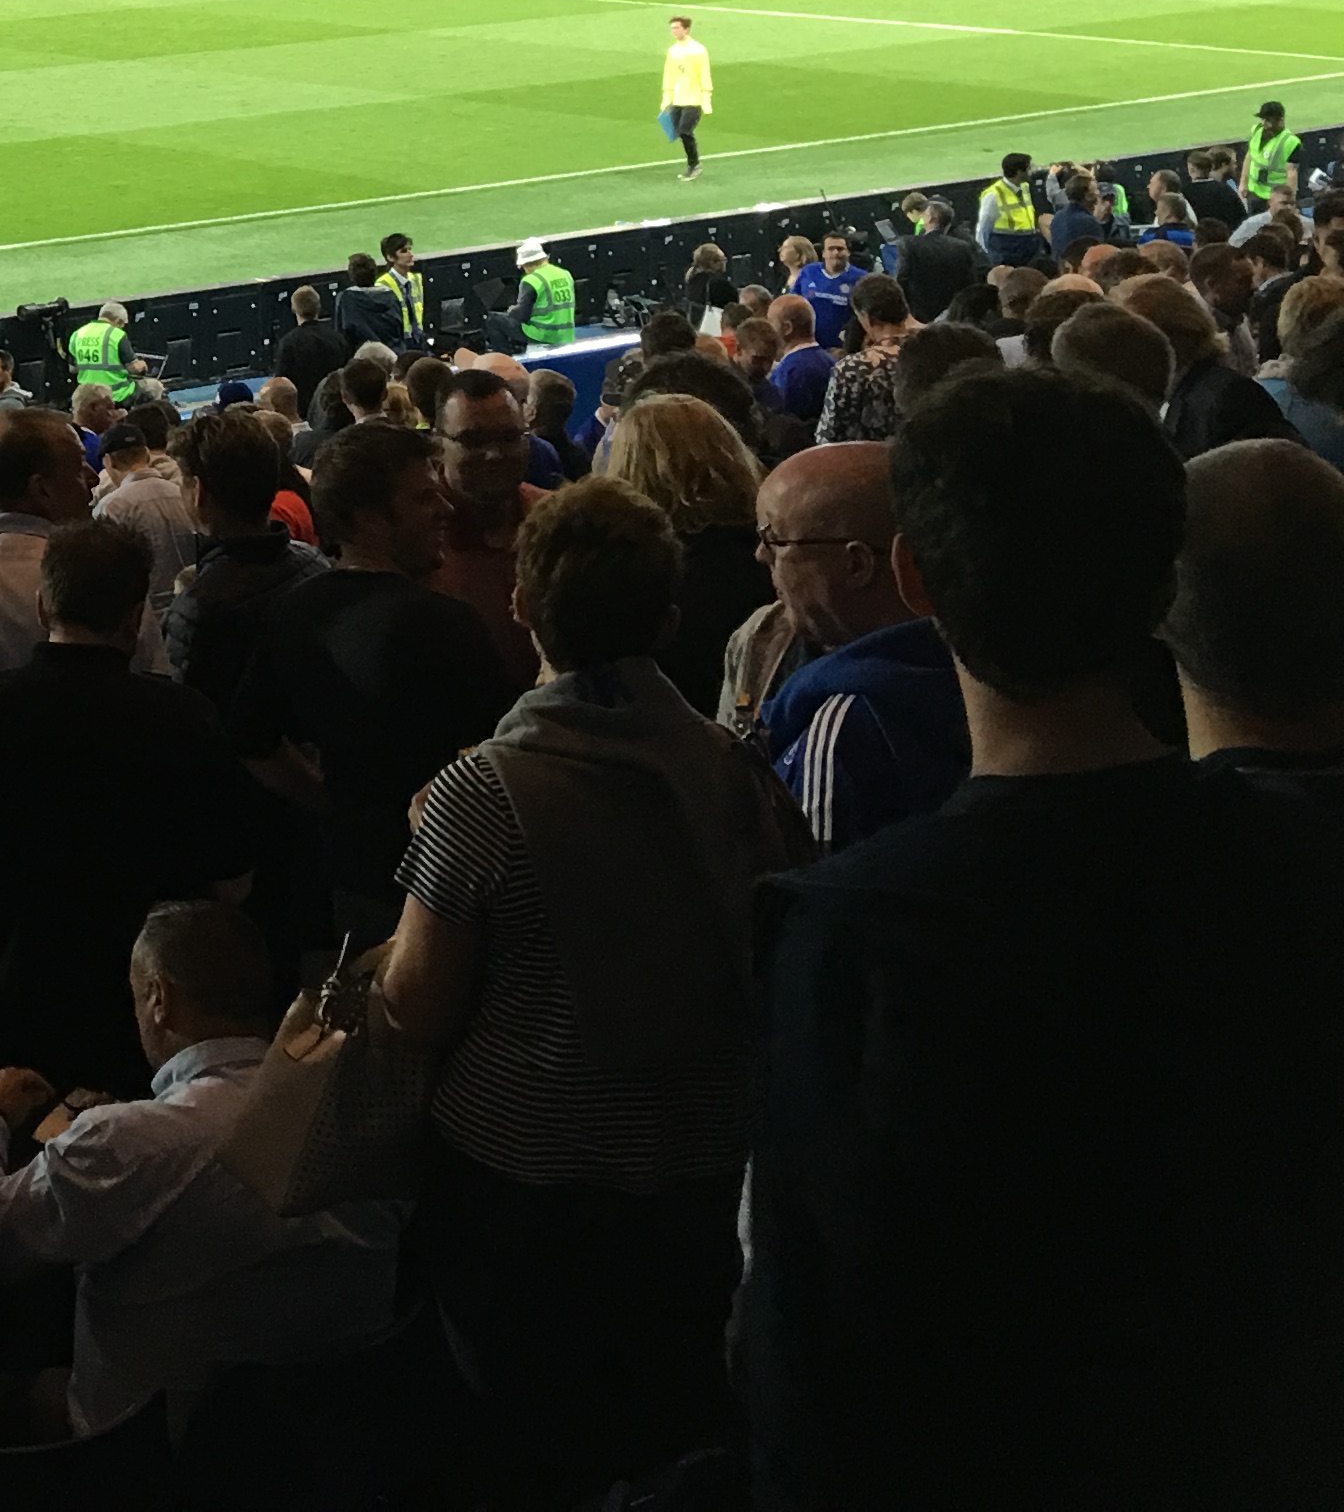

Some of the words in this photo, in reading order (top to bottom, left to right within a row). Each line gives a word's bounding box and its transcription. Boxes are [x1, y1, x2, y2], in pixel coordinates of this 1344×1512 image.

[554, 289, 571, 303] 033
[78, 337, 100, 347] PRESS
[78, 349, 100, 363] 046
